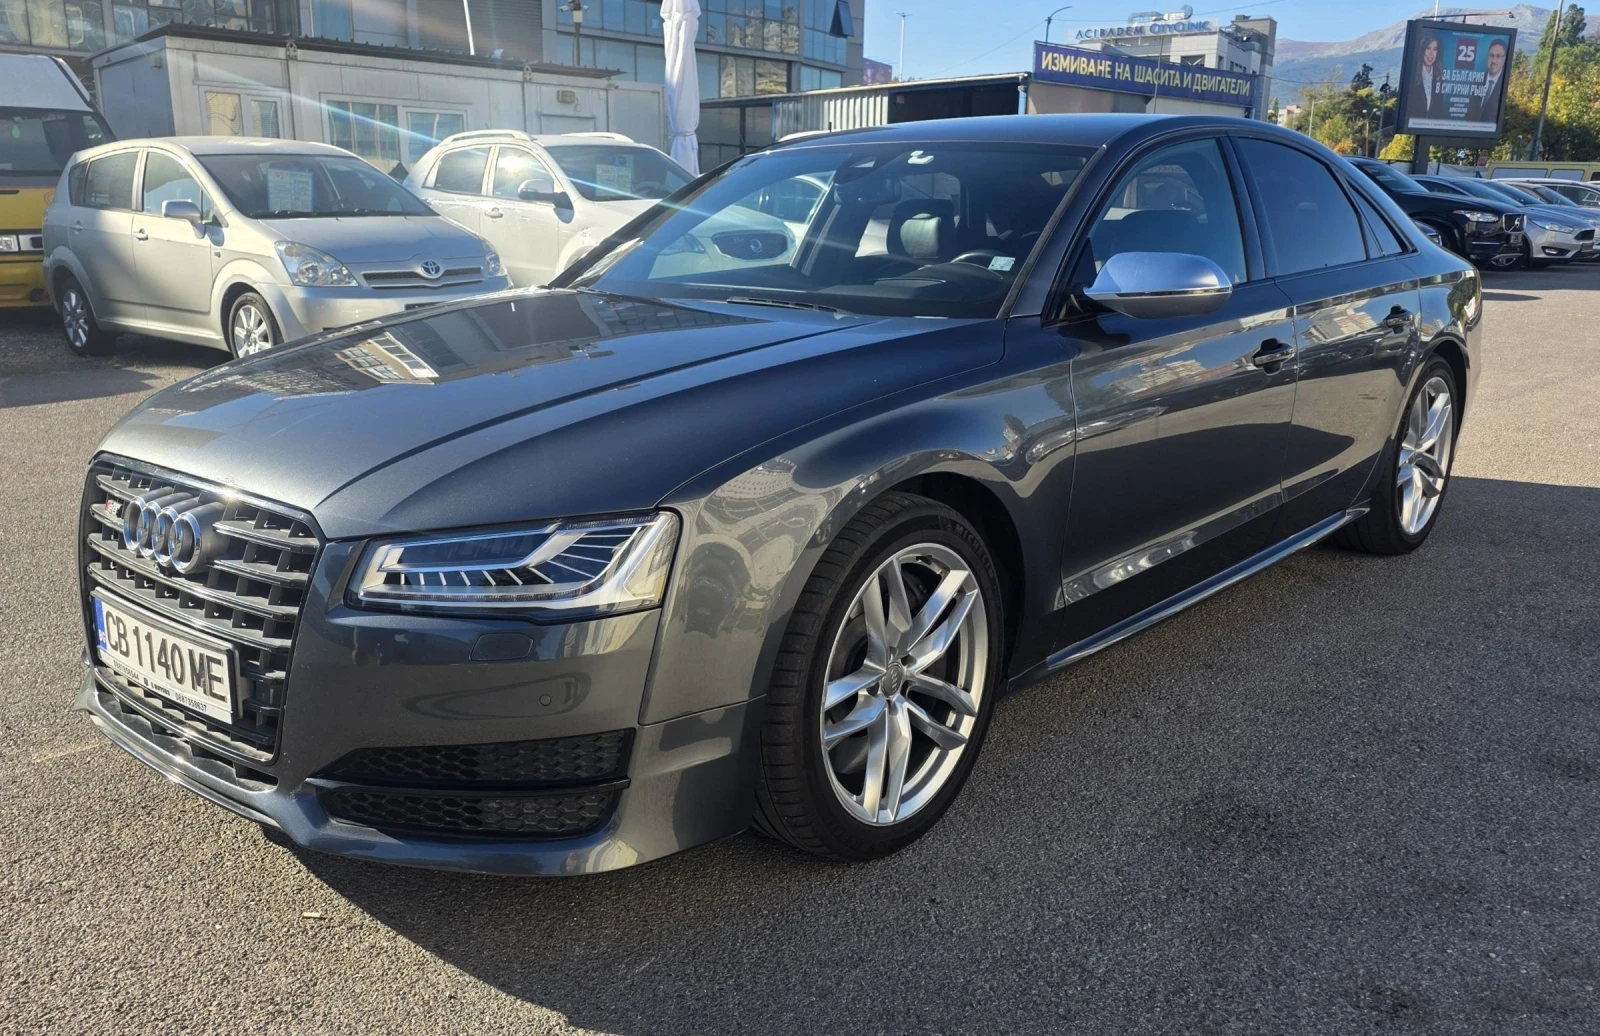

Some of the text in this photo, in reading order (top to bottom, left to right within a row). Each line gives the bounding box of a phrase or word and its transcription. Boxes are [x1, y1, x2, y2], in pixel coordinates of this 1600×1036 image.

[1075, 26, 1145, 39] ACIBADEM
[1457, 45, 1475, 61] 25
[1041, 51, 1251, 96] ИЗМИВАНЕ НА ШАСИТА И ДВИГАТЕЛИ
[1442, 70, 1485, 82] ЗА БЪЛГАРИЯ
[1435, 82, 1441, 93] В
[1441, 83, 1469, 95] СИГУРНИ
